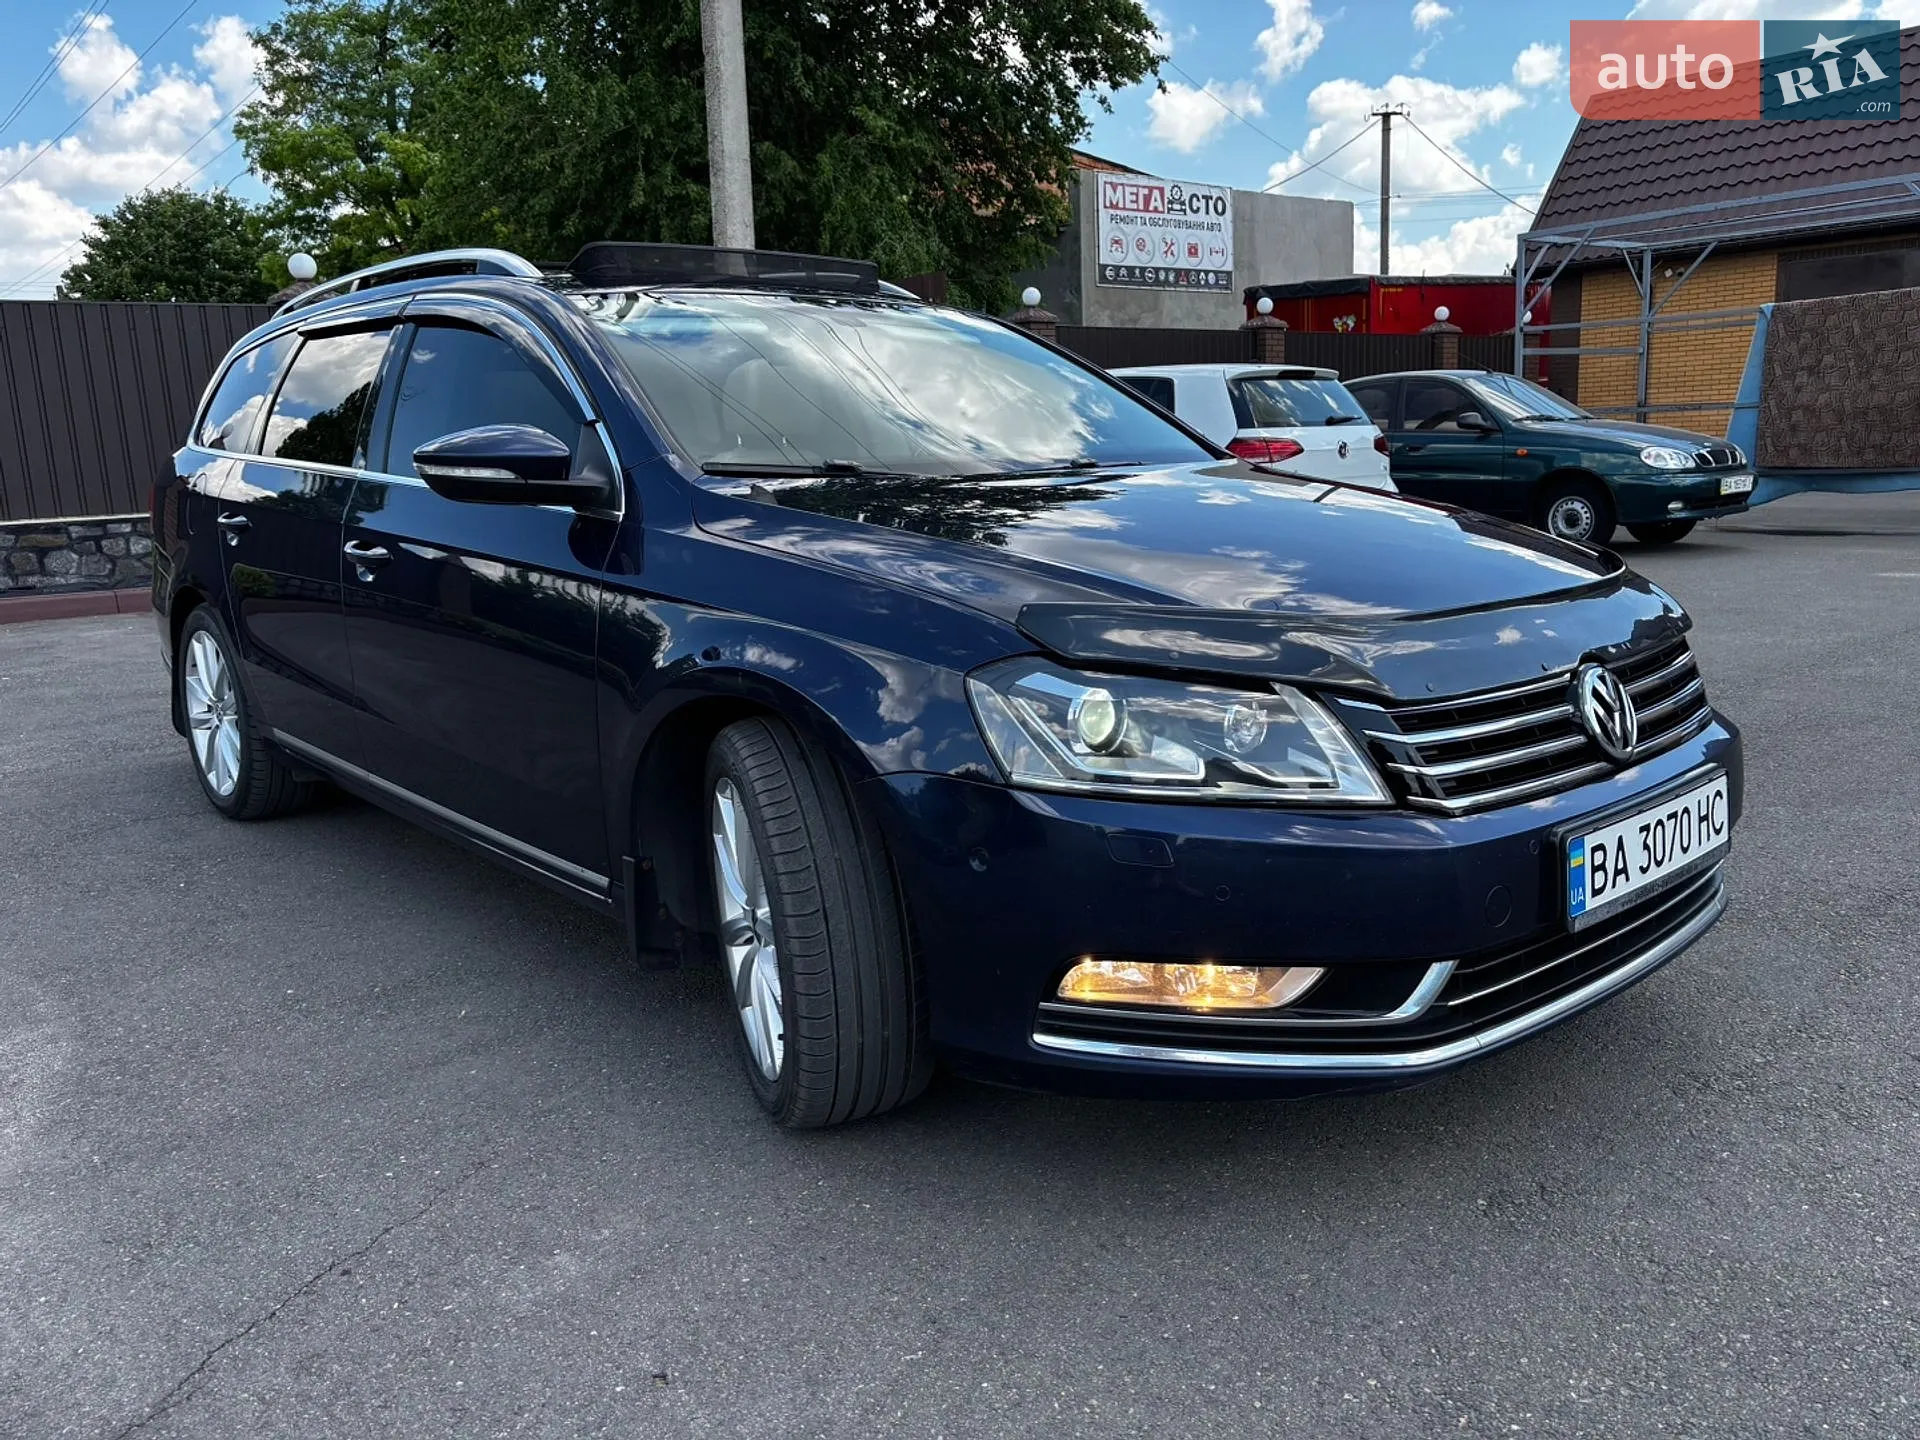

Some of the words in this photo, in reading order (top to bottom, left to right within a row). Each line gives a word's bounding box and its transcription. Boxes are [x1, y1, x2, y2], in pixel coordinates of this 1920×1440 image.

[1105, 183, 1165, 213] МЕГА
[1188, 193, 1227, 217] СТО
[1110, 214, 1138, 226] РЕМОНТ
[1206, 221, 1222, 233] АВТО
[1590, 834, 1631, 898] BA
[1638, 806, 1692, 874] 3070
[1697, 789, 1725, 847] HC
[1570, 886, 1585, 906] UA
